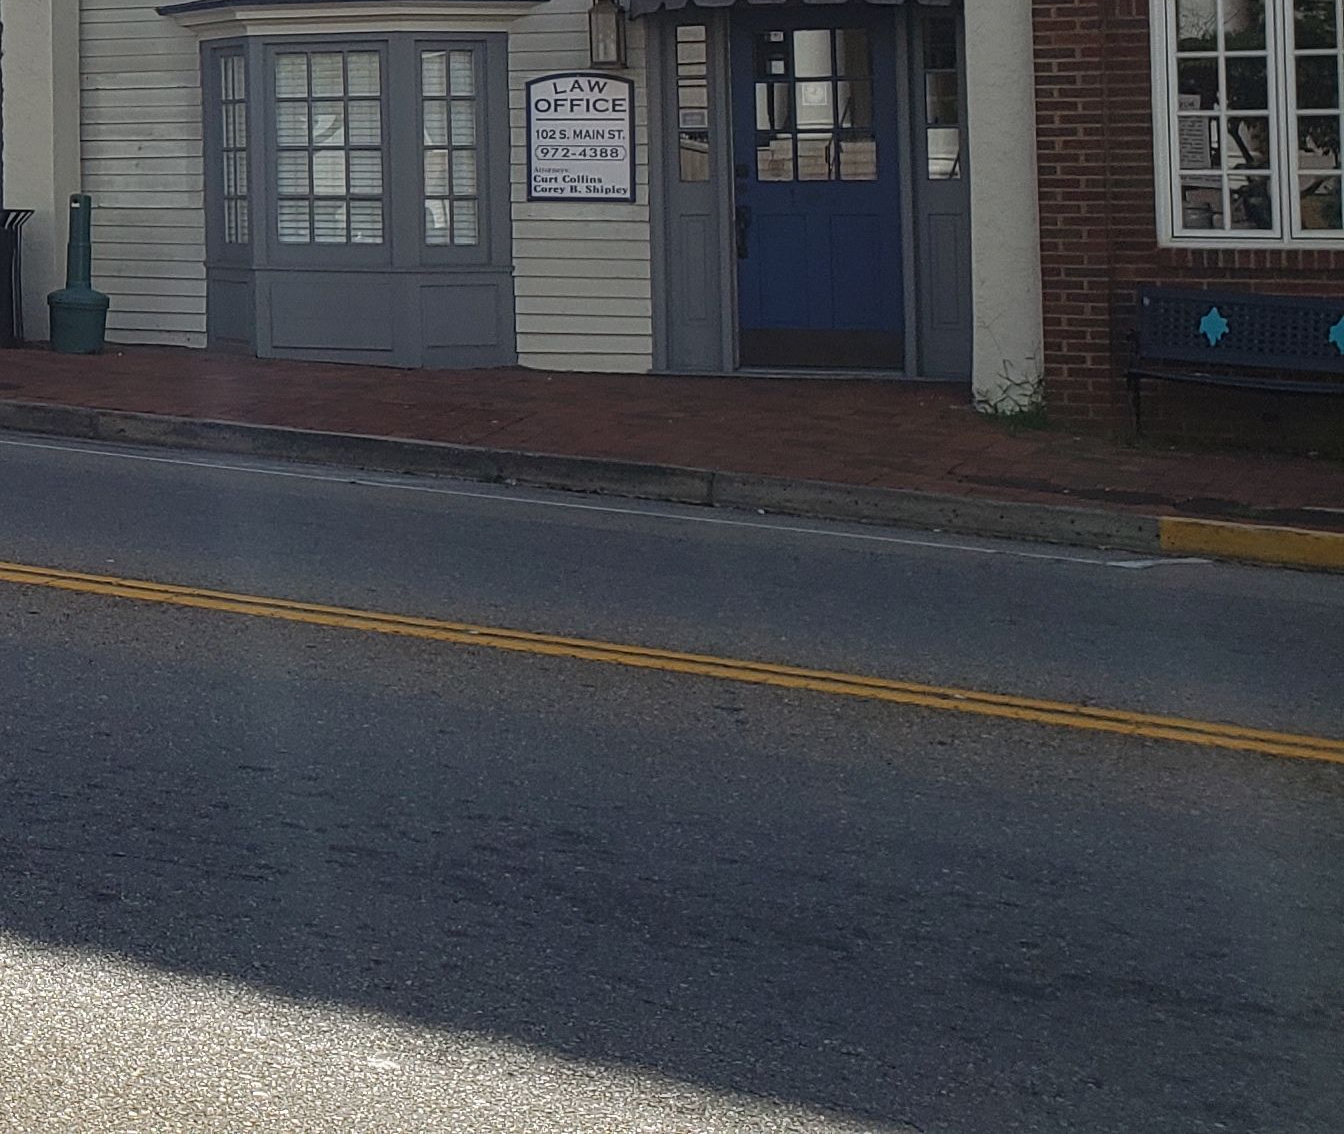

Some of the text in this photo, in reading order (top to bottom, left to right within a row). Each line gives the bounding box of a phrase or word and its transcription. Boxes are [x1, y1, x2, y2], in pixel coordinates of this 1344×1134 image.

[553, 79, 607, 94] LAW
[534, 98, 627, 113] OFFICE
[535, 129, 626, 140] 102 S. MAIN ST.
[540, 147, 619, 158] 972-4388
[533, 174, 603, 184] Curt Collins
[533, 185, 628, 195] Corey B. Shipley
